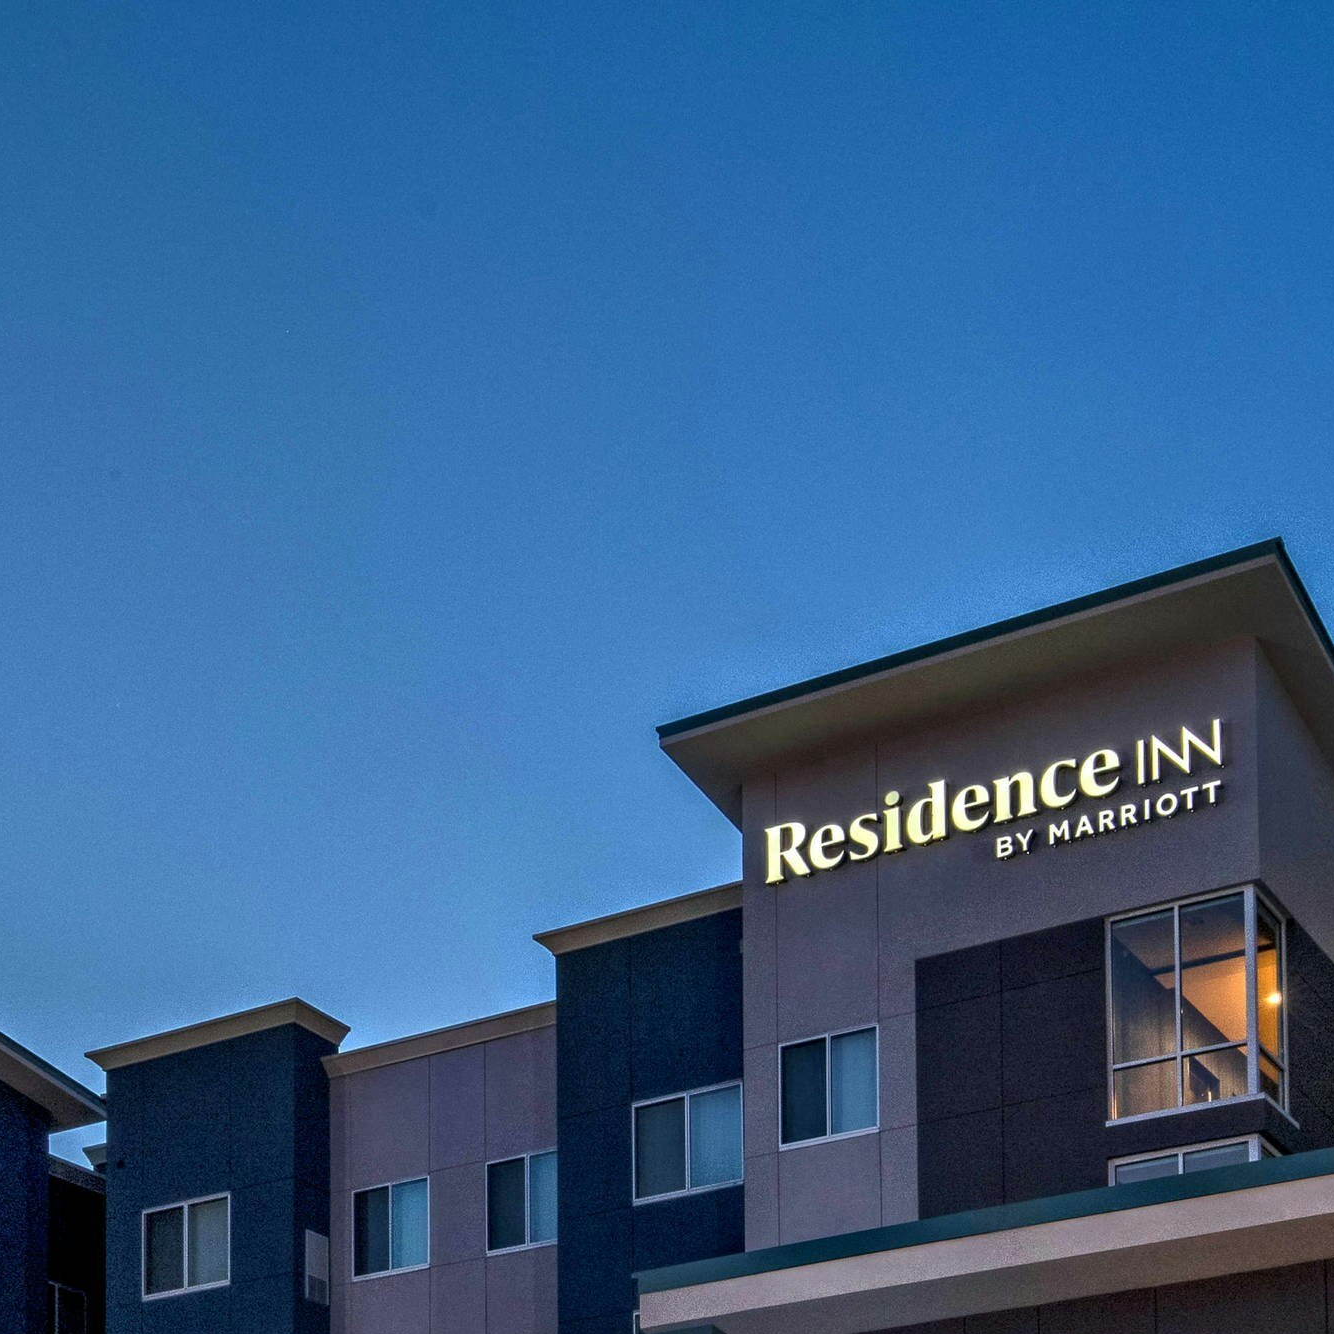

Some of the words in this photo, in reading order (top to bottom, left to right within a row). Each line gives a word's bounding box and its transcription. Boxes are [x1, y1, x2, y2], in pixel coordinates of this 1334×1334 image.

[764, 748, 1121, 884] Residence
[1136, 718, 1223, 785] INN
[995, 829, 1034, 859] BY
[1048, 779, 1222, 845] MARRIOTT
